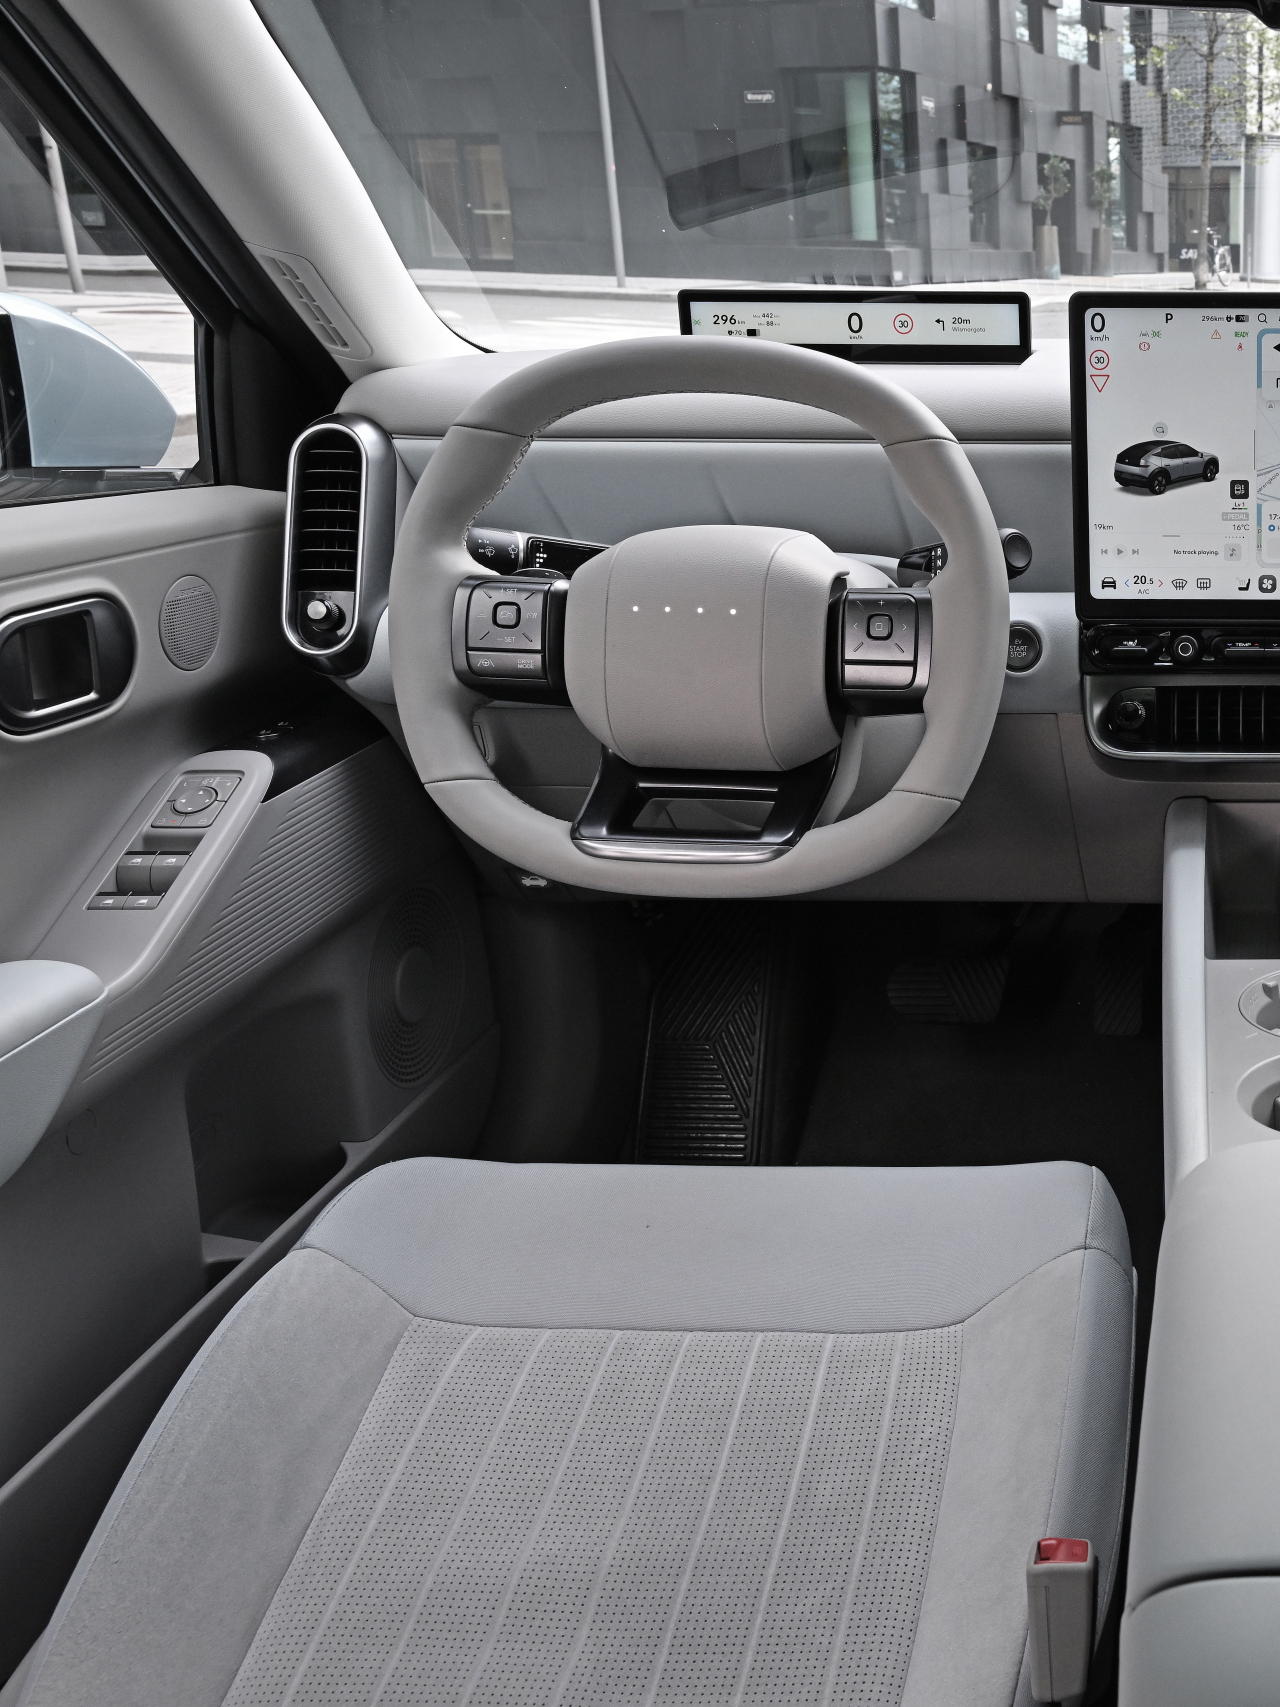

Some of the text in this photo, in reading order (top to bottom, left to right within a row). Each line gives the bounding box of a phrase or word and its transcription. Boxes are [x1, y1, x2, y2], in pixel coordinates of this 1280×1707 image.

[712, 314, 737, 325] 296
[951, 316, 971, 325] 20m
[1090, 312, 1106, 333] 0
[1165, 312, 1173, 324] P
[847, 312, 863, 334] 0
[898, 320, 909, 329] 30
[1090, 334, 1110, 342] km/h
[1094, 356, 1105, 365] 30
[1094, 523, 1114, 531] 19km
[1232, 523, 1250, 531] 16°C
[937, 547, 942, 556] R
[936, 558, 942, 567] N
[1133, 575, 1154, 585] 20.5
